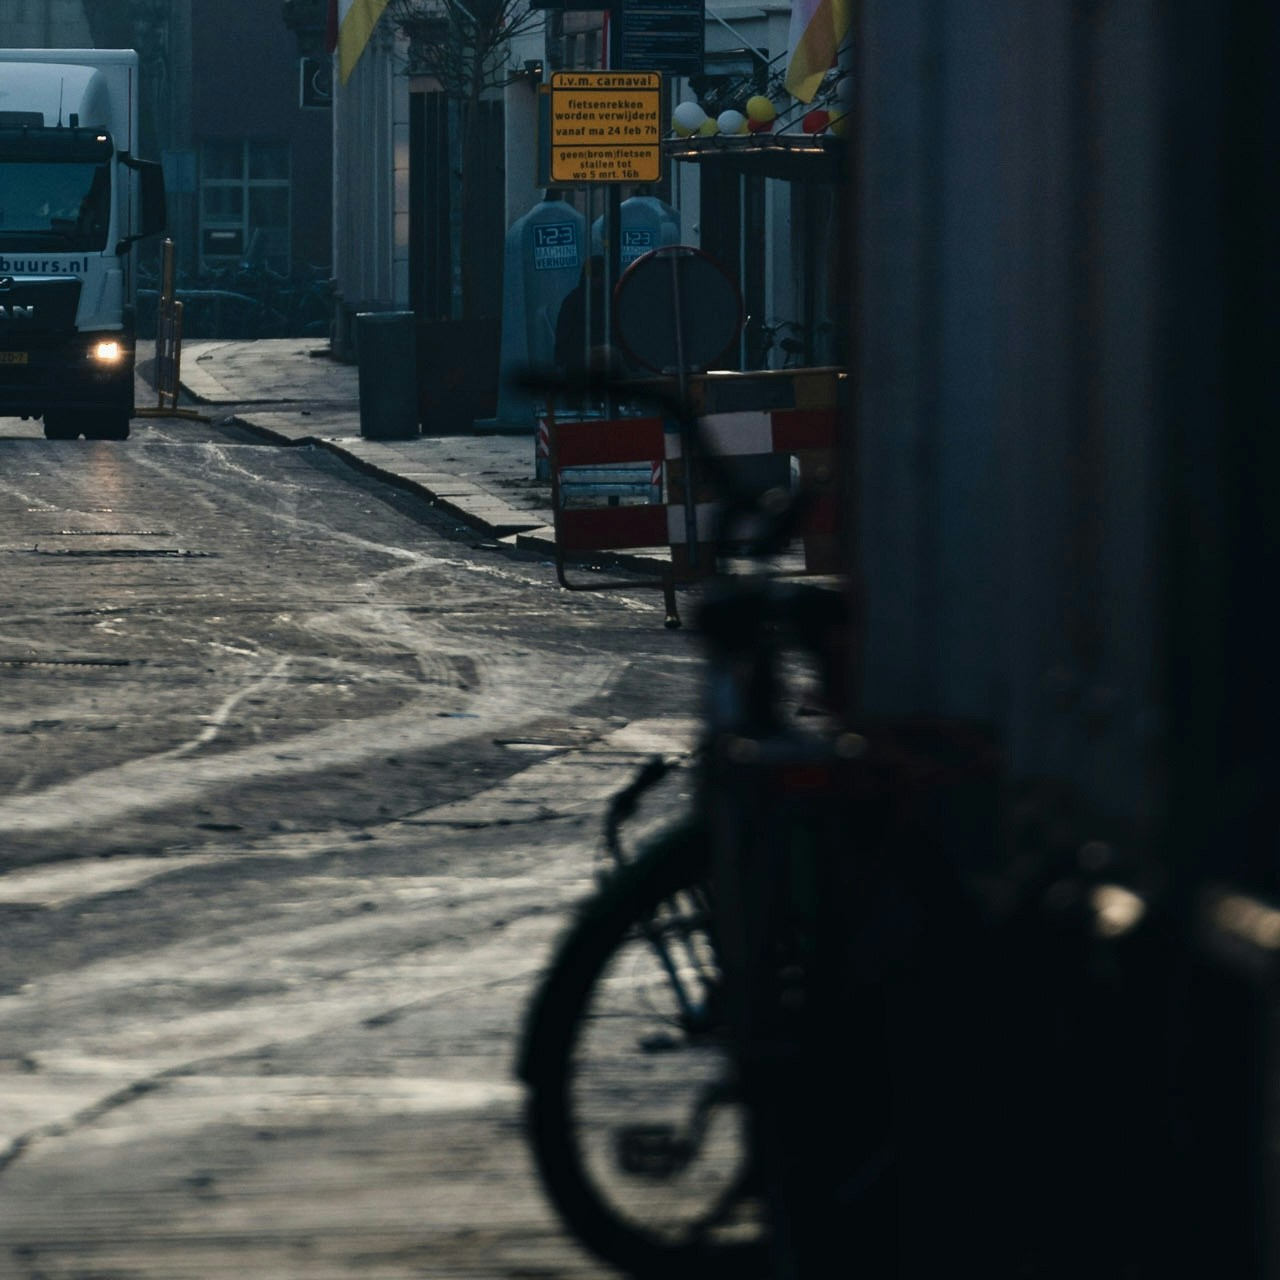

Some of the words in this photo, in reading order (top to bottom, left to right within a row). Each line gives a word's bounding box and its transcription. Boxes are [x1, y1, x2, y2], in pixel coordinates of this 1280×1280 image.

[559, 75, 593, 86] i.v.m.
[597, 75, 651, 86] carnaval
[568, 100, 643, 109] fietsenrekken
[555, 111, 595, 120] worden
[599, 111, 656, 122] verwijderd
[556, 127, 585, 136] vanaf
[589, 128, 604, 136] ma
[607, 126, 621, 135] 24
[624, 126, 641, 135] feb
[644, 125, 657, 134] 7h
[580, 160, 614, 169] stallen
[617, 160, 632, 168] tot
[572, 171, 587, 179] wo
[590, 170, 596, 179] 5
[622, 169, 639, 178] 16h
